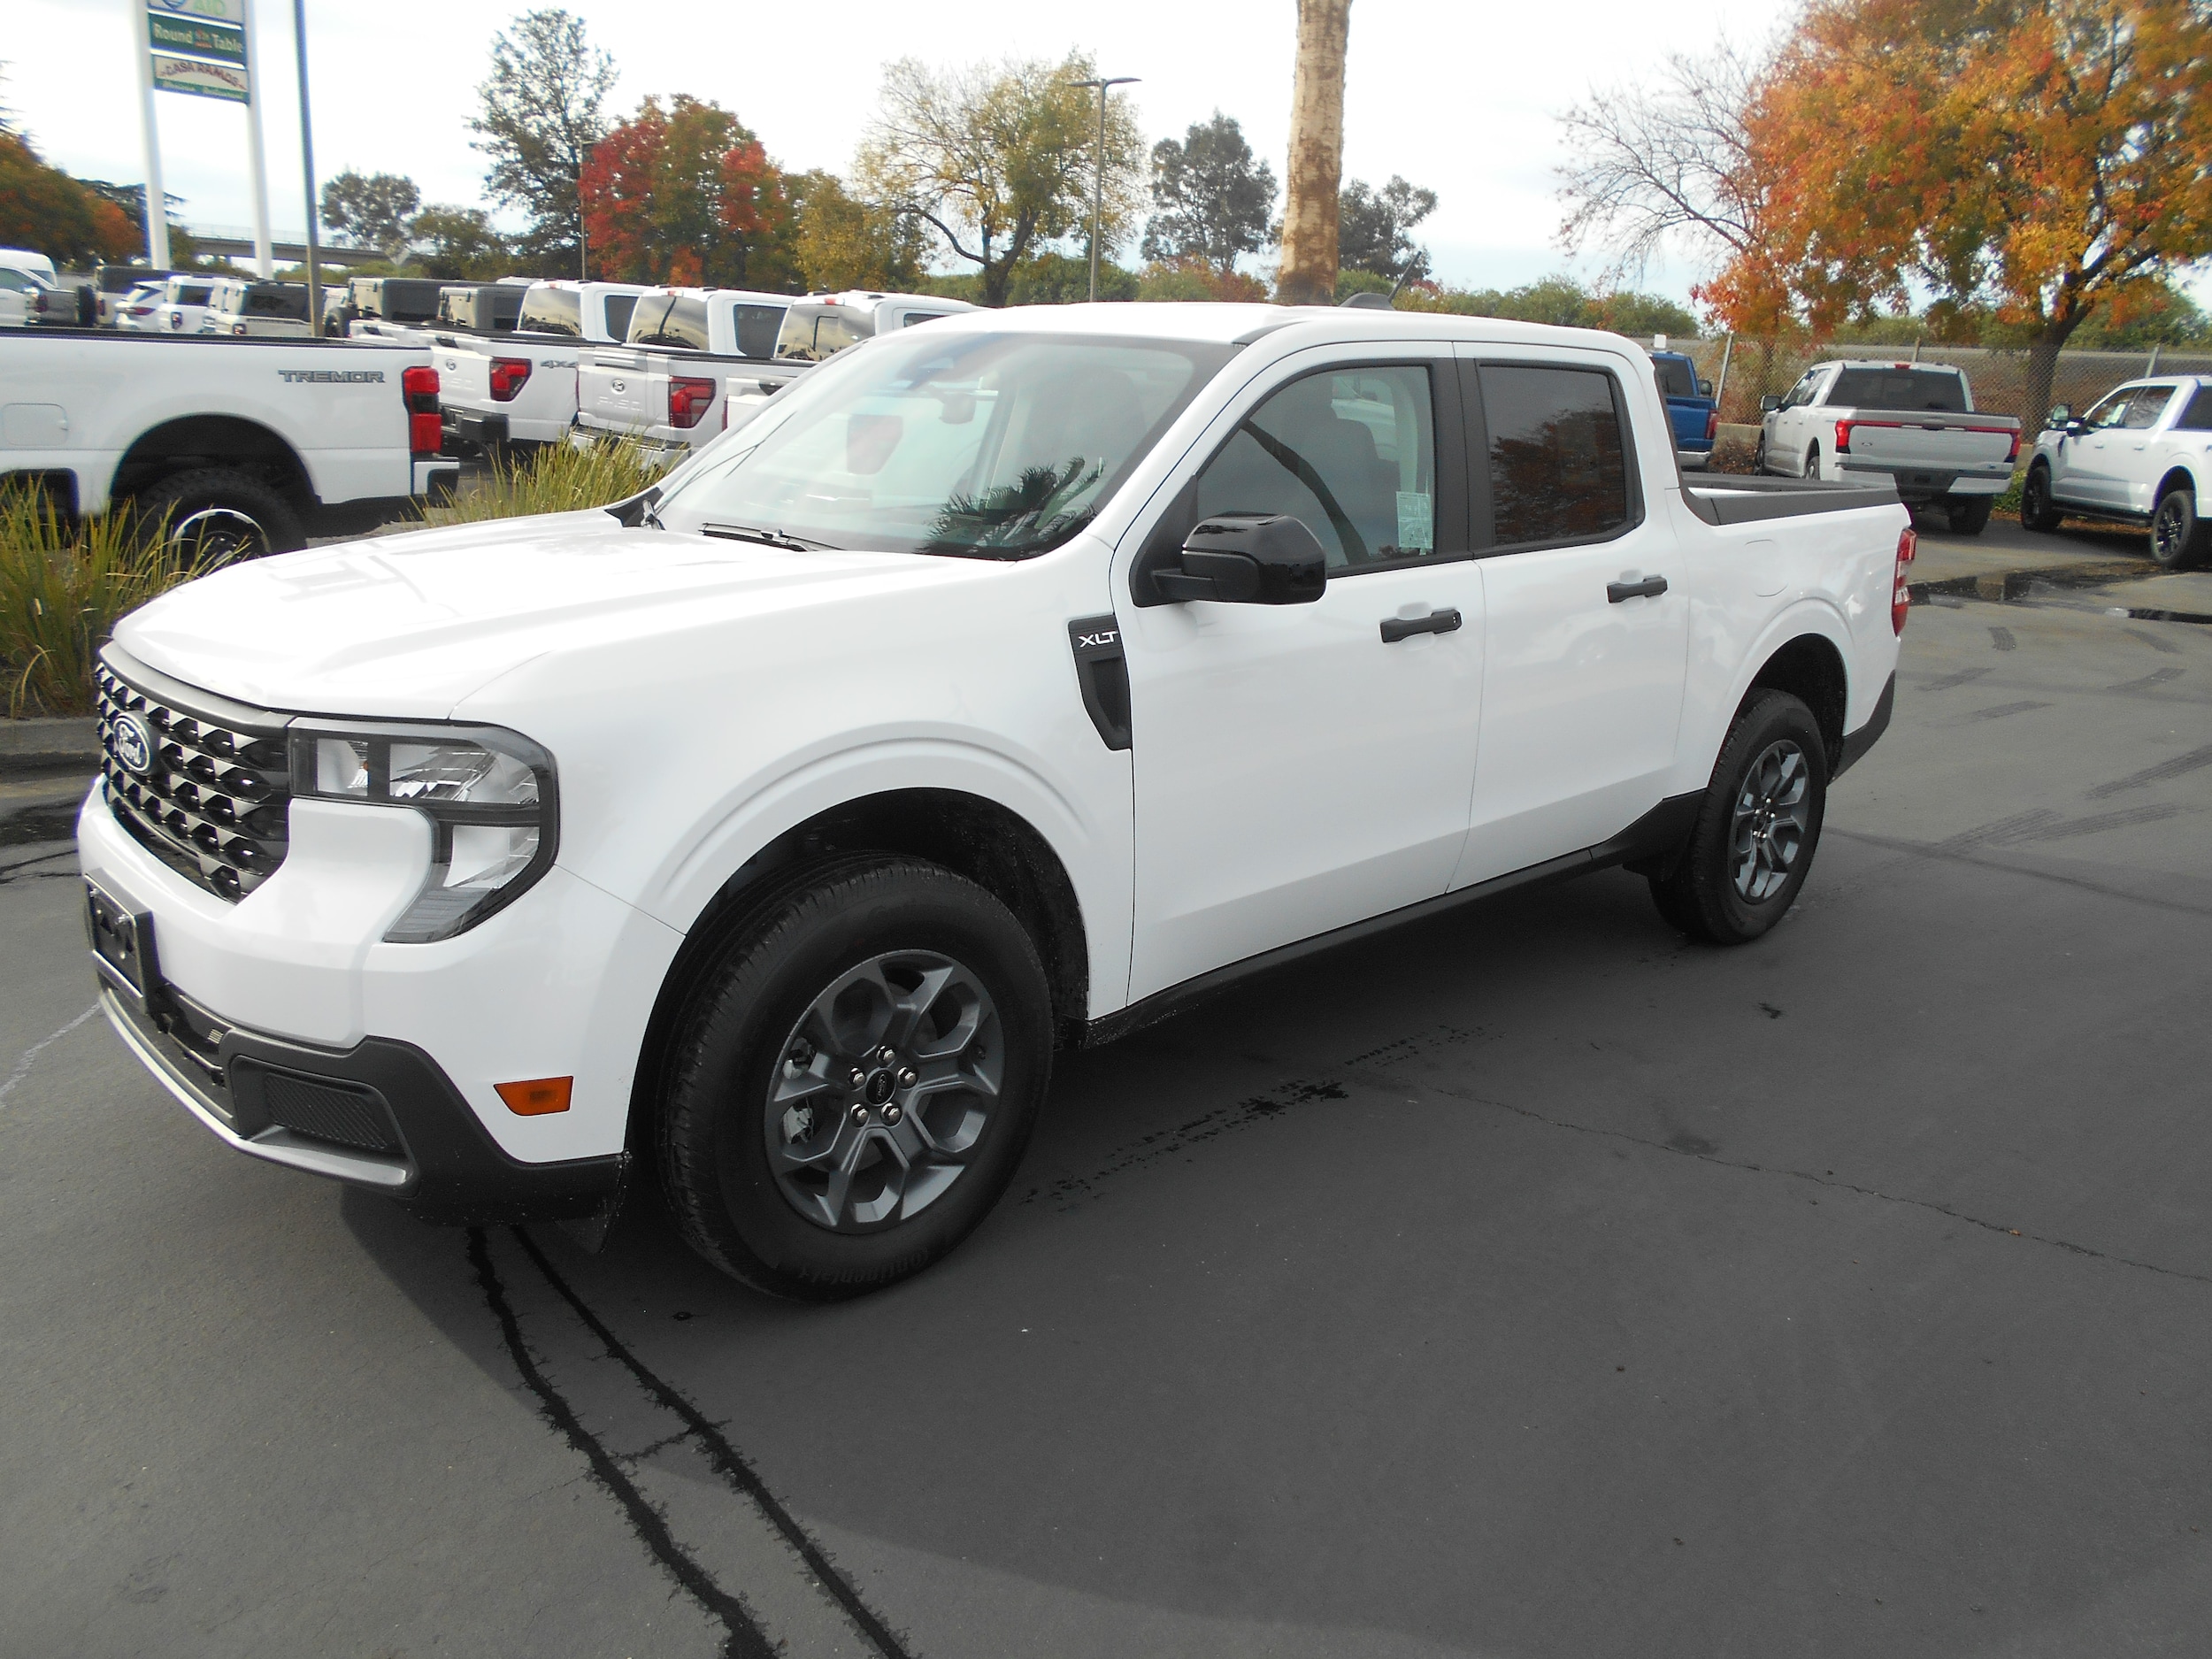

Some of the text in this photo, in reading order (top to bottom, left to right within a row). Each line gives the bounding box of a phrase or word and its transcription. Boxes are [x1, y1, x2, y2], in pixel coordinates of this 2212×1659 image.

[153, 22, 243, 53] Round Table
[278, 370, 386, 383] TREMOR
[1078, 630, 1119, 648] XLT
[118, 722, 142, 765] Ford
